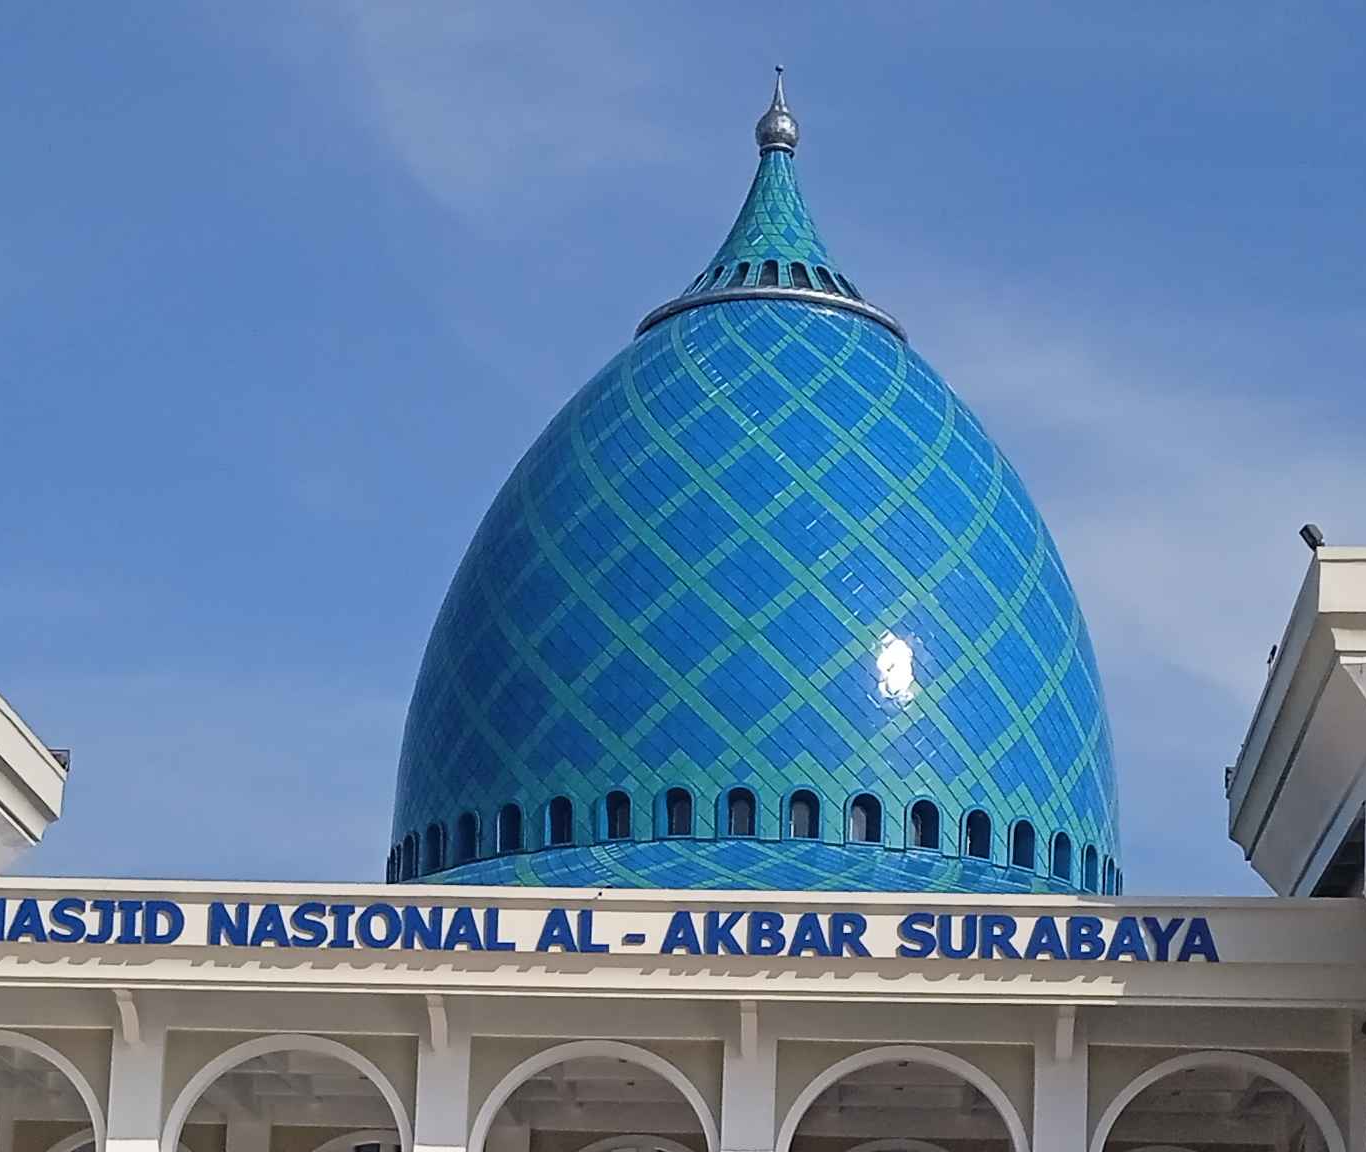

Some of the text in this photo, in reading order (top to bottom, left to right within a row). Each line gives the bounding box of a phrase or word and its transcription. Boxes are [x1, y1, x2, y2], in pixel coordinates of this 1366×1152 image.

[207, 901, 515, 952] NASIONAL
[537, 907, 609, 953] AL
[661, 908, 870, 957] AKBAR
[896, 911, 1220, 962] SURABAYA
